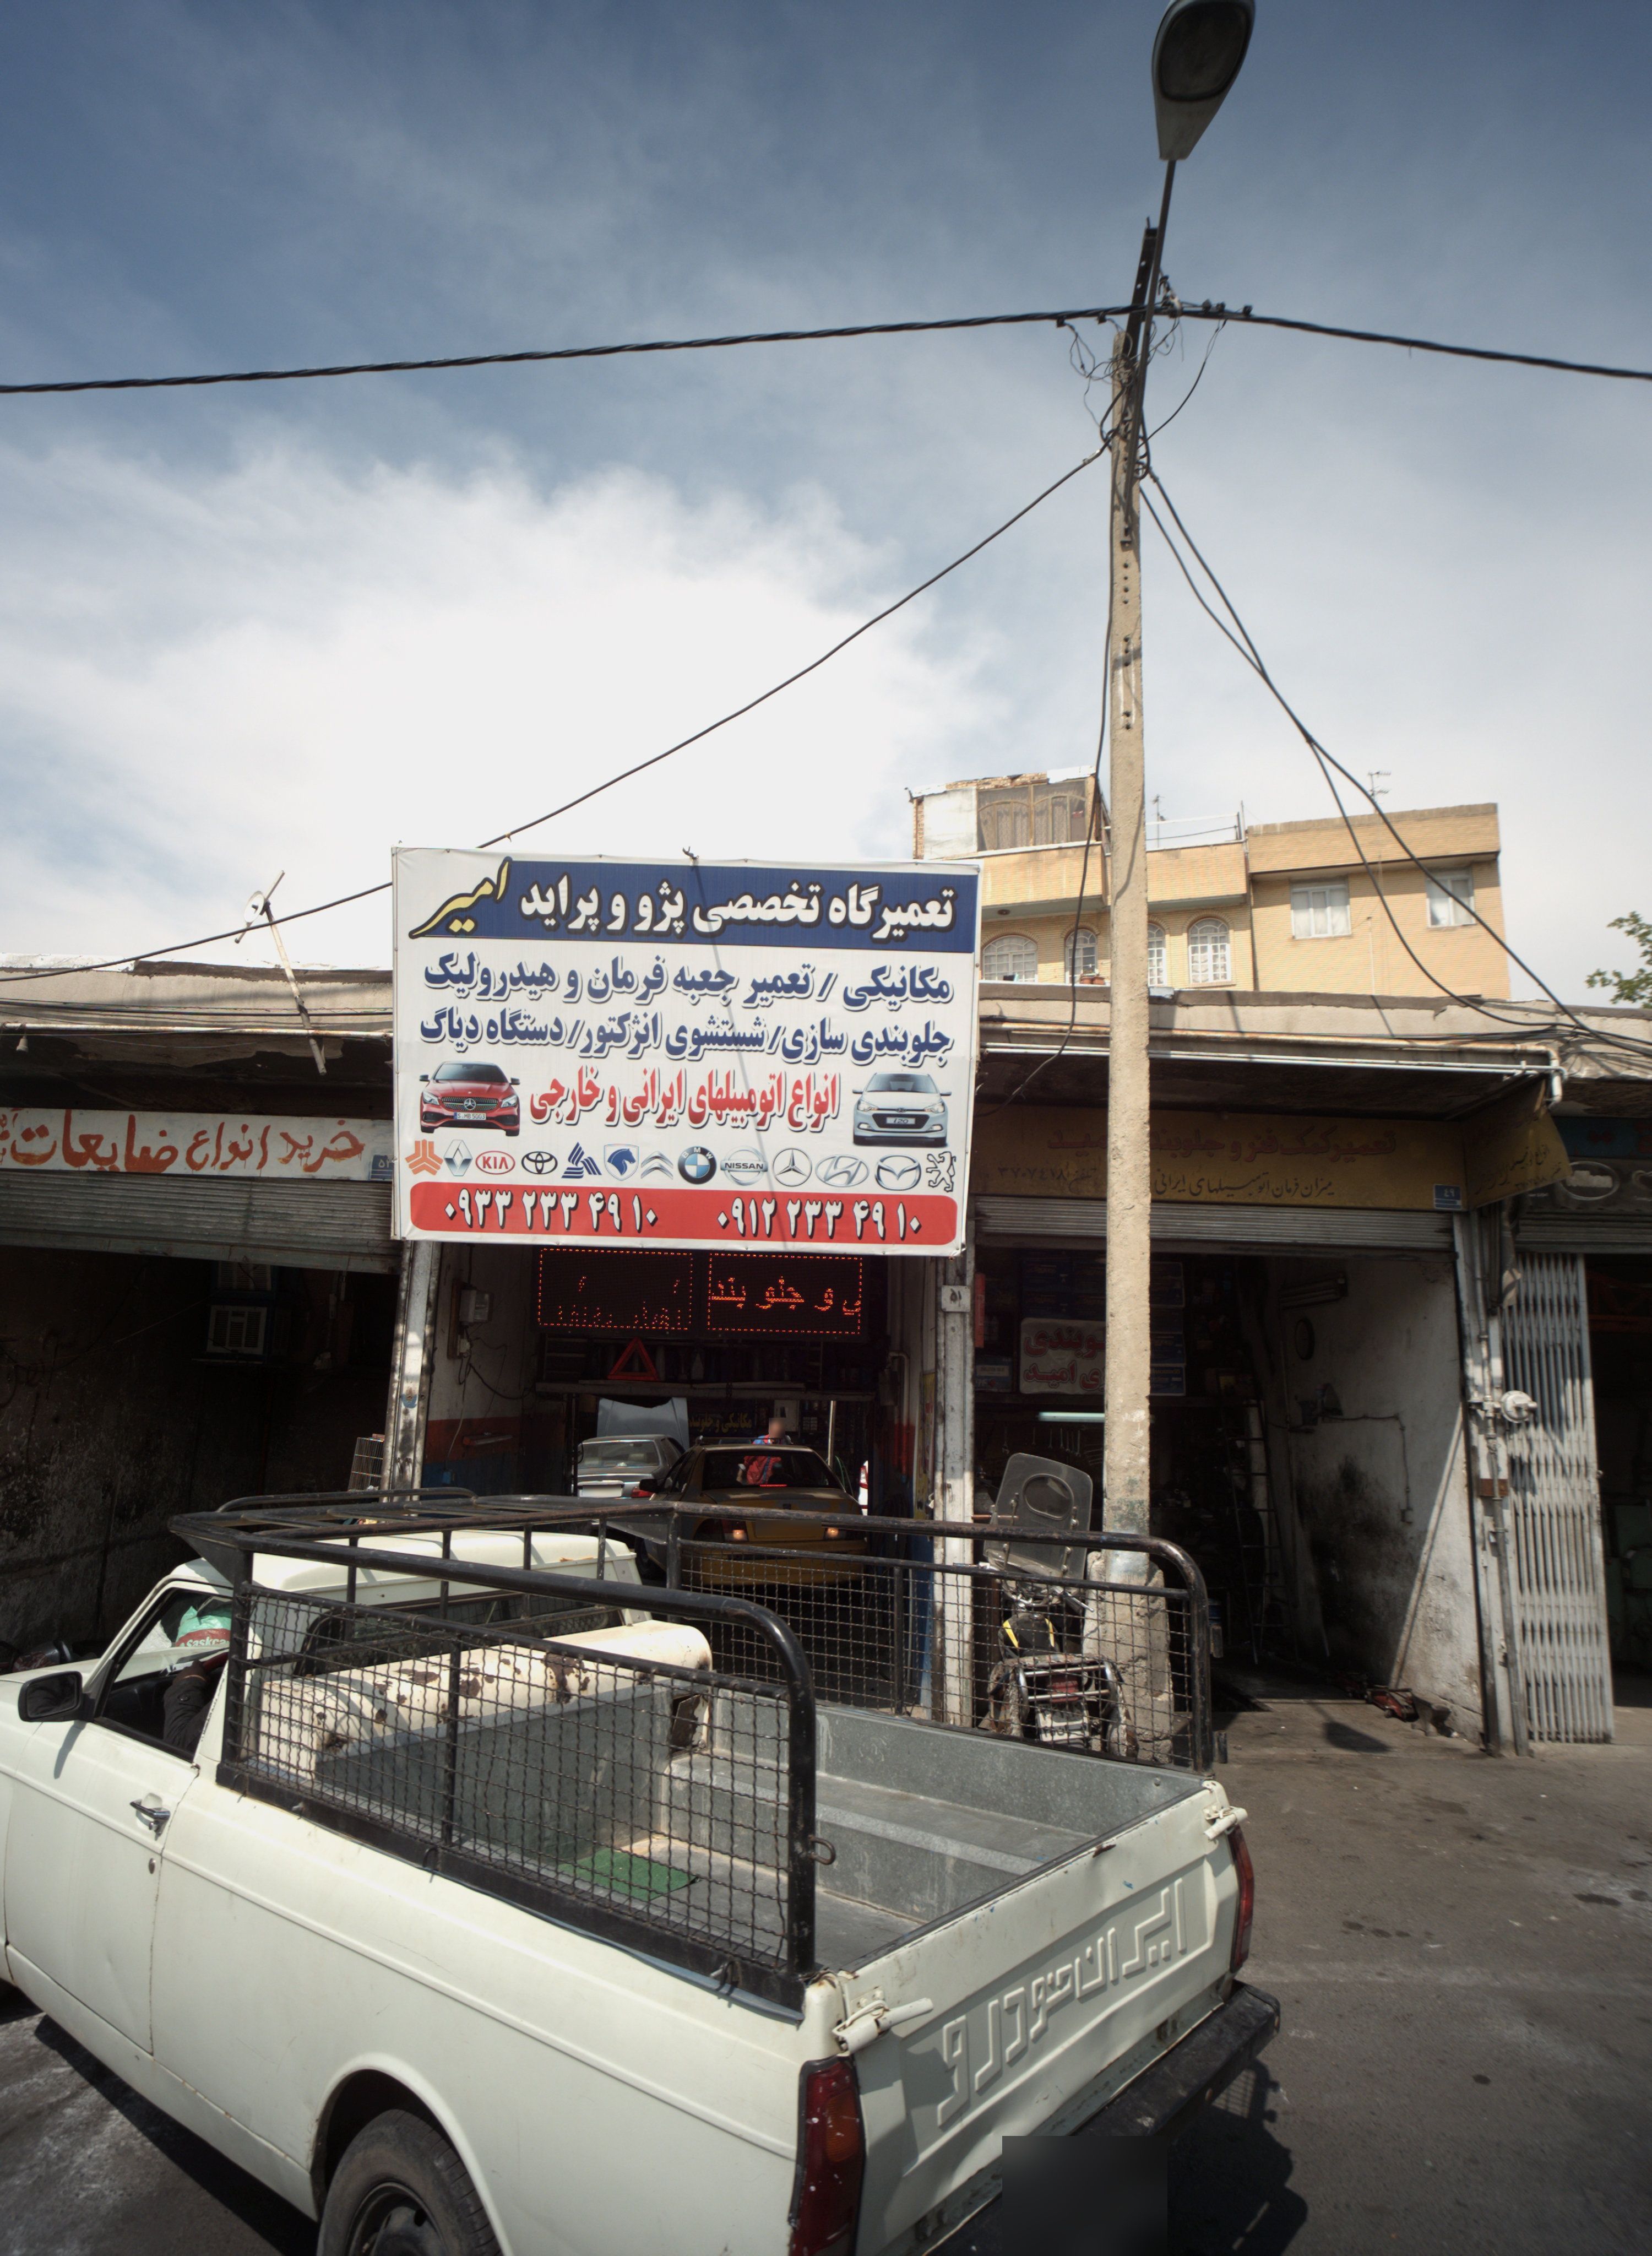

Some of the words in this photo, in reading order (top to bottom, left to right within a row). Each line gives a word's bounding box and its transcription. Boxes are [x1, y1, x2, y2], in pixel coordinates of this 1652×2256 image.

[410, 858, 511, 937] امیر
[520, 872, 601, 932] پراید
[606, 892, 627, 932] و
[632, 878, 685, 935] پژو
[692, 880, 823, 934] تخصصی
[828, 882, 955, 940] تعمیرگاه
[424, 952, 559, 1001] هیدرولیک
[563, 968, 582, 1004] و
[587, 955, 668, 1005] فرمان
[672, 966, 739, 1005] جعبه
[742, 963, 816, 1008] تعمیر
[843, 964, 954, 1011] مکانیکی
[420, 1006, 482, 1052] دیاگ
[851, 1019, 954, 1067] جلوبندی
[529, 1065, 605, 1124] خارجی
[605, 1084, 620, 1127] و
[622, 1067, 686, 1127] ایرانی
[688, 1069, 786, 1132] اتومبیلهای
[787, 1072, 840, 1134] انواع
[10, 1108, 178, 1173] ضایعات
[186, 1121, 271, 1171] انواع
[278, 1119, 366, 1173] خرید
[482, 1156, 509, 1169] KIA
[682, 1147, 713, 1159] BMW
[1150, 1128, 1225, 1158] جلوبند
[444, 1187, 513, 1228] ۰۹۳۳
[522, 1190, 578, 1230] ۲۳۳
[1272, 1178, 1299, 1197] فرمان
[716, 1197, 777, 1237] ۰۹۱۲
[786, 1198, 844, 1238] ۲۳۳
[1024, 1360, 1078, 1388] امید
